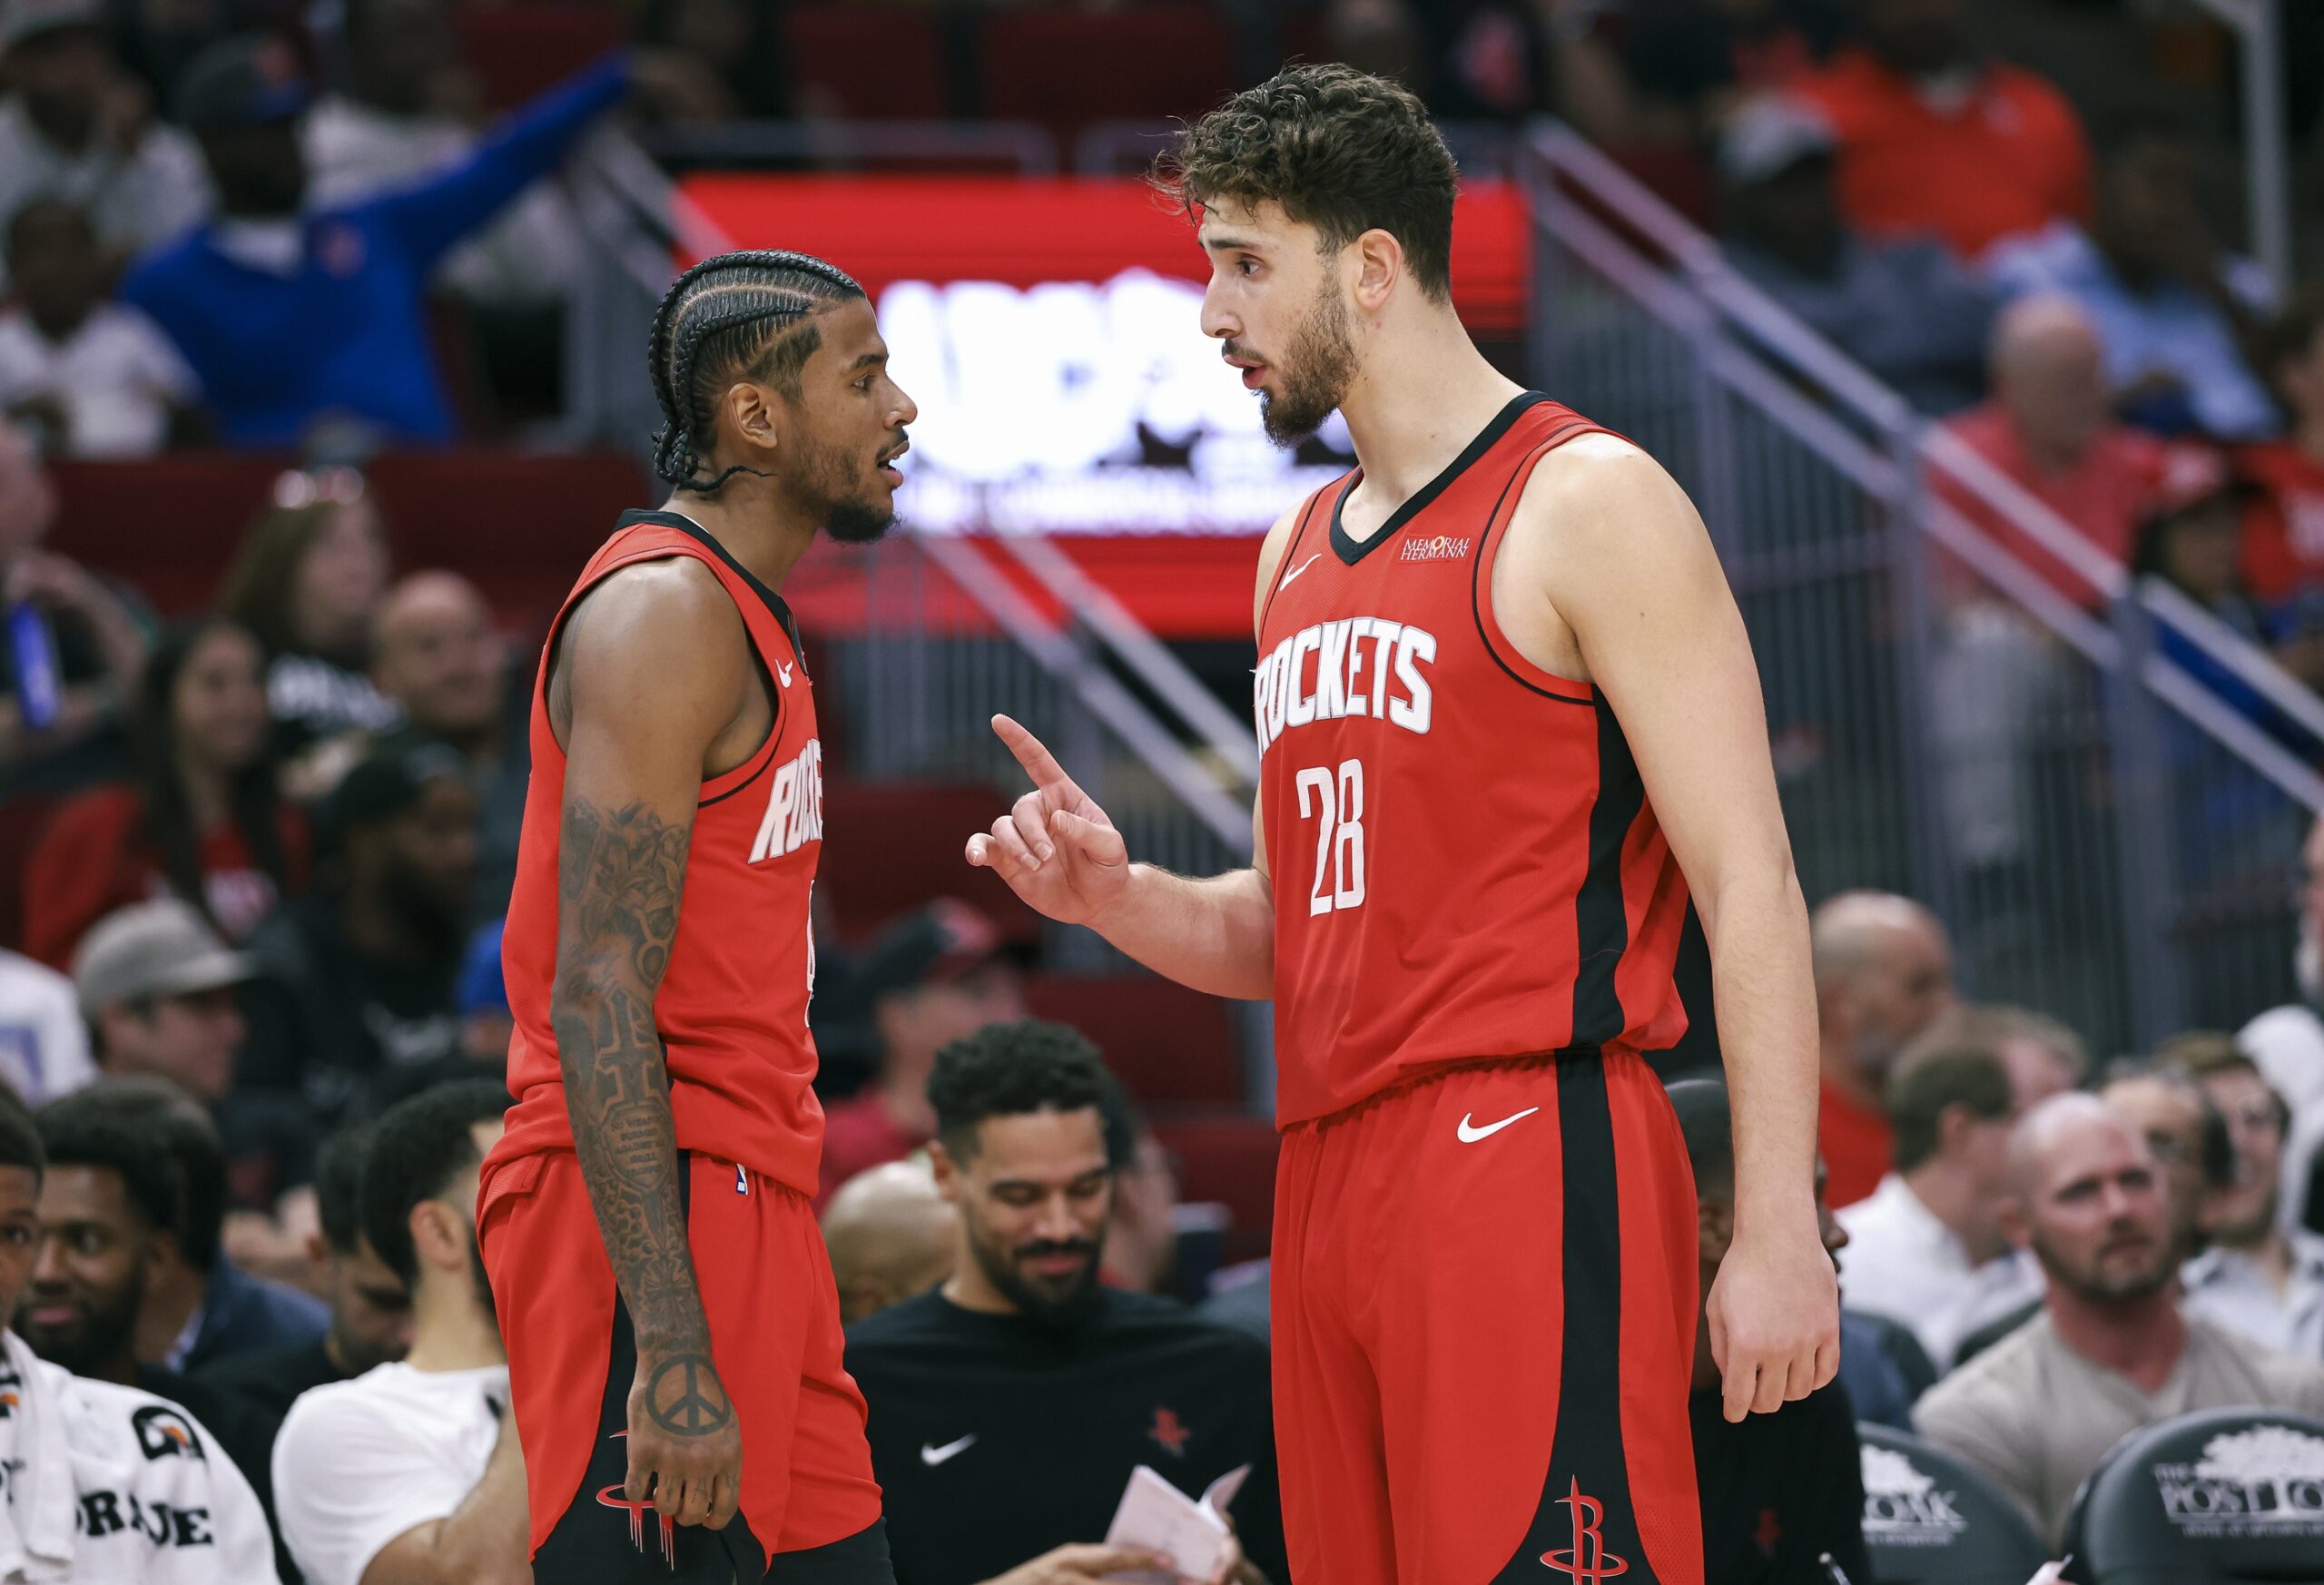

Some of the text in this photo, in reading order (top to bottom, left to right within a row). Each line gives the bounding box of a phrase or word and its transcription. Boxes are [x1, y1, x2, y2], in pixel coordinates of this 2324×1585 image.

[1401, 547, 1467, 560] HERMANN
[1404, 536, 1470, 551] MEMORIAL
[1255, 616, 1437, 763] ROCKETS
[1295, 758, 1365, 918] 28
[2161, 1478, 2262, 1521] POST
